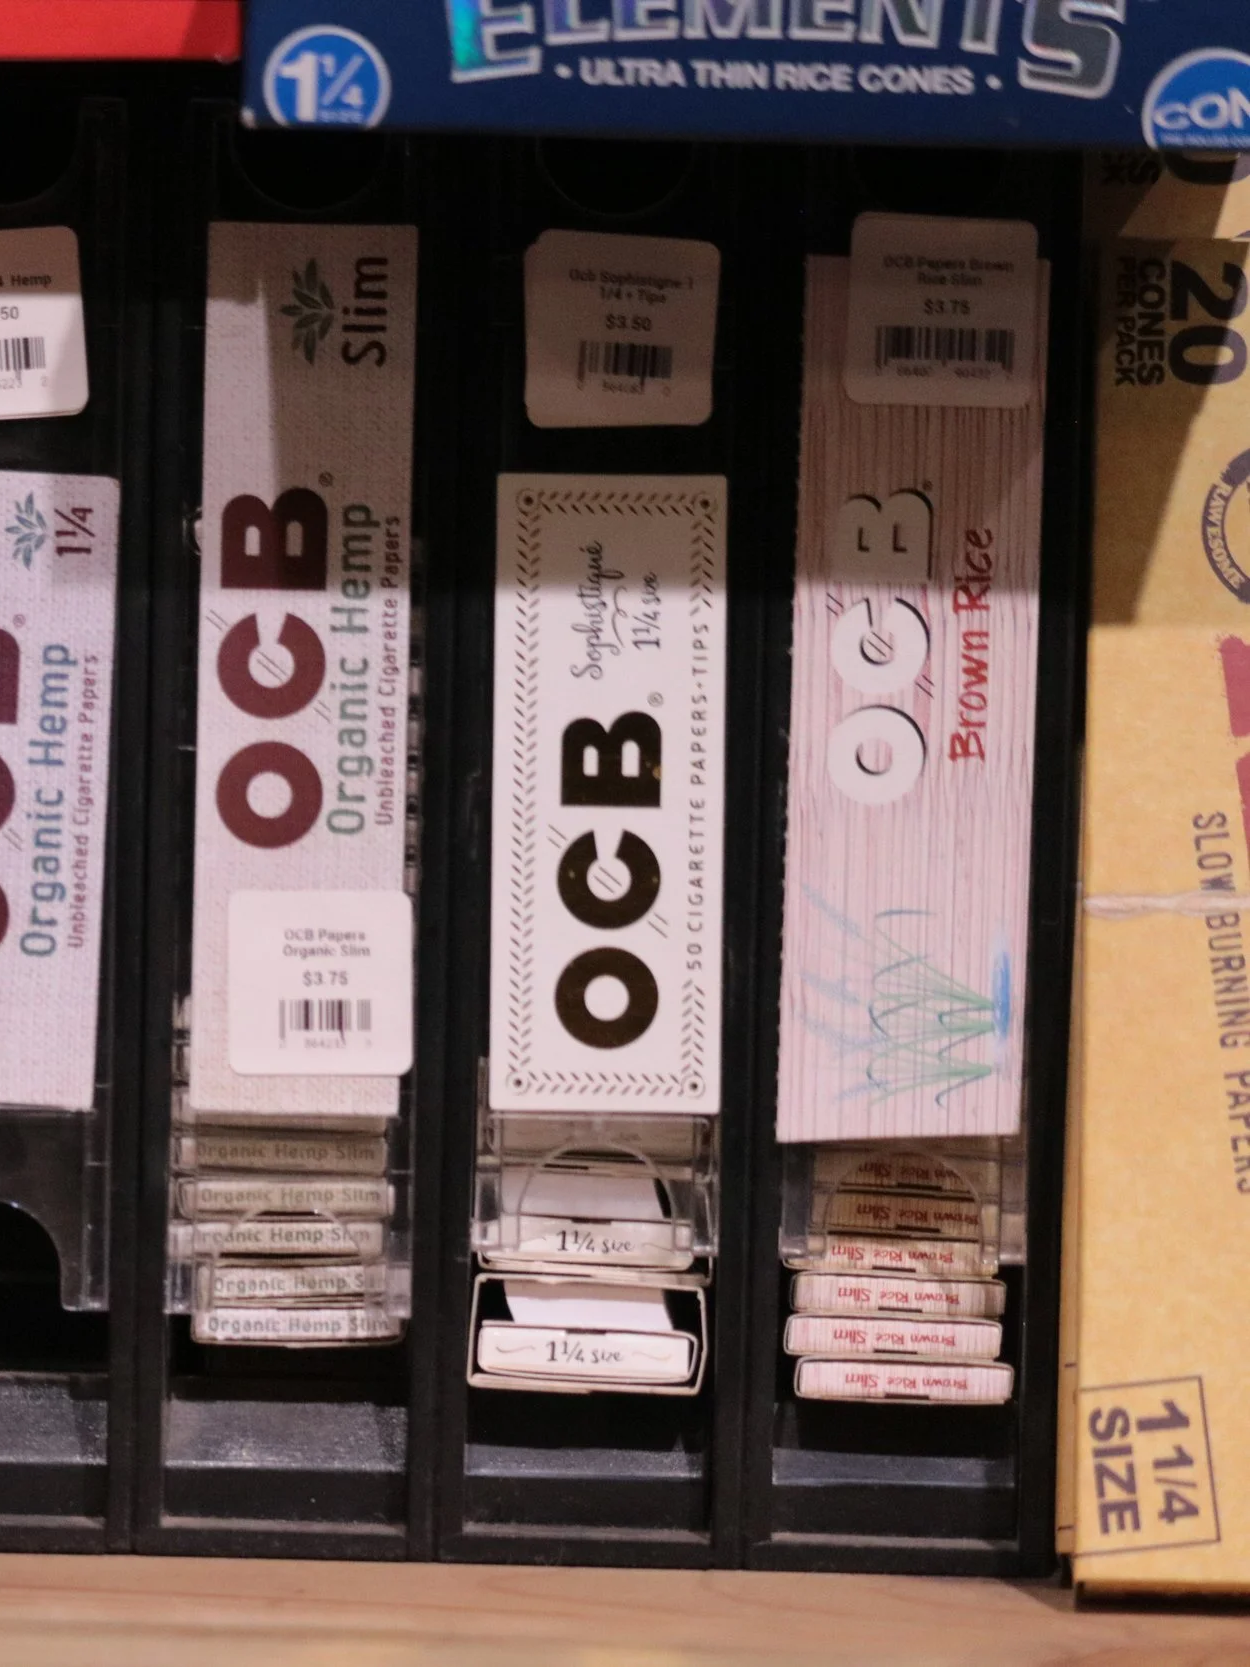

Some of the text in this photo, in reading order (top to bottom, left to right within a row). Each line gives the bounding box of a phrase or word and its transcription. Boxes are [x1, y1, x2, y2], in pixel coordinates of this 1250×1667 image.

[445, 0, 1126, 99] ELEMENTS
[579, 58, 976, 96] ULTRA THIN RICE CONES
[11, 274, 52, 289] Hemp
[341, 256, 389, 368] Slim
[1115, 315, 1136, 387] PACK
[1136, 259, 1166, 386] CONES
[1168, 261, 1248, 387] 20
[215, 487, 328, 849] OCB
[326, 504, 380, 836] Organic Hemp
[374, 515, 401, 827] Unbleached Cigarette Papers
[826, 487, 934, 805] OCB
[948, 526, 994, 763] Brown Rice
[19, 643, 79, 958] Organic Hemp
[67, 654, 99, 949] Unbleached Cigarette Papers
[686, 623, 710, 971] 50 CIGARETTE PAPERS TIPS
[554, 710, 662, 1050] OCB
[1193, 811, 1236, 893] SLOW
[282, 944, 371, 960] Organic Slim
[284, 929, 366, 943] OCB Papers
[302, 970, 349, 987] $3.75
[1205, 911, 1250, 1049] BURNING
[280, 1144, 328, 1161] Hemp
[338, 1144, 376, 1160] Slim
[201, 1187, 382, 1204] Organic Hemp Slim
[270, 1228, 324, 1244] Hemp
[600, 1239, 635, 1254] size
[831, 1244, 865, 1261] Slim
[214, 1277, 284, 1294] Organic
[293, 1276, 348, 1292] Hemp
[837, 1286, 871, 1301] Slim
[208, 1316, 390, 1334] Organic Hemp Slim
[590, 1350, 624, 1365] size
[833, 1328, 868, 1343] Slim
[845, 1372, 880, 1388] Slim
[1089, 1406, 1142, 1536] SIZE
